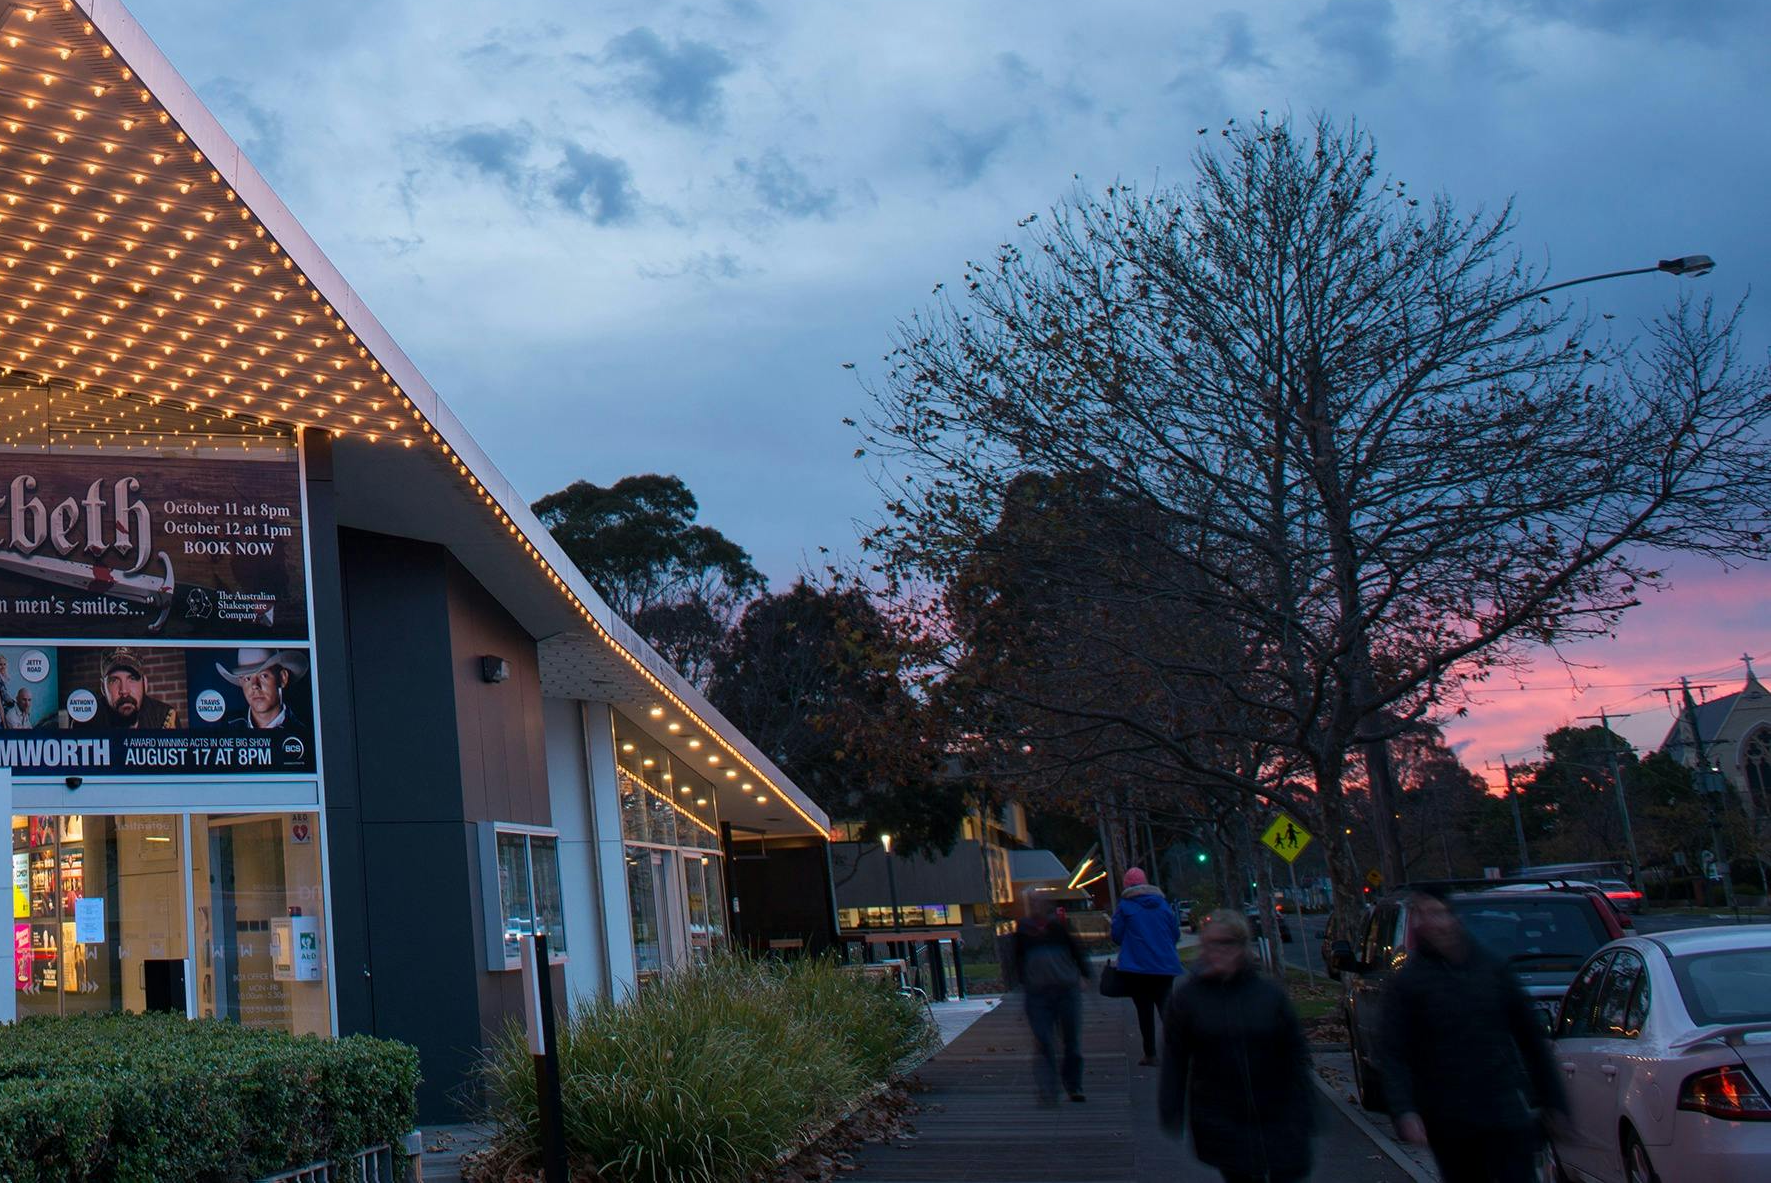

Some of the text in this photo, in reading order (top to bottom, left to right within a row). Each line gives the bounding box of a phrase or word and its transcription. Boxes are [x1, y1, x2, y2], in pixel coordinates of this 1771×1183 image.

[164, 500, 290, 519] October 11 at 8pm
[164, 520, 292, 539] October 12 at 1pm
[183, 540, 274, 556] BOOK NOW
[216, 590, 276, 601] The Australian
[15, 595, 66, 615] men's
[217, 600, 267, 611] Shakespeare
[218, 610, 258, 622] Company
[200, 698, 220, 706] TRAVIS
[198, 705, 224, 713] SINCLAIR
[123, 738, 271, 747] 4 AWARD WINNING ACTS IN ONE BIG SHOW
[124, 748, 272, 766] AUGUST 17 AT 8PM
